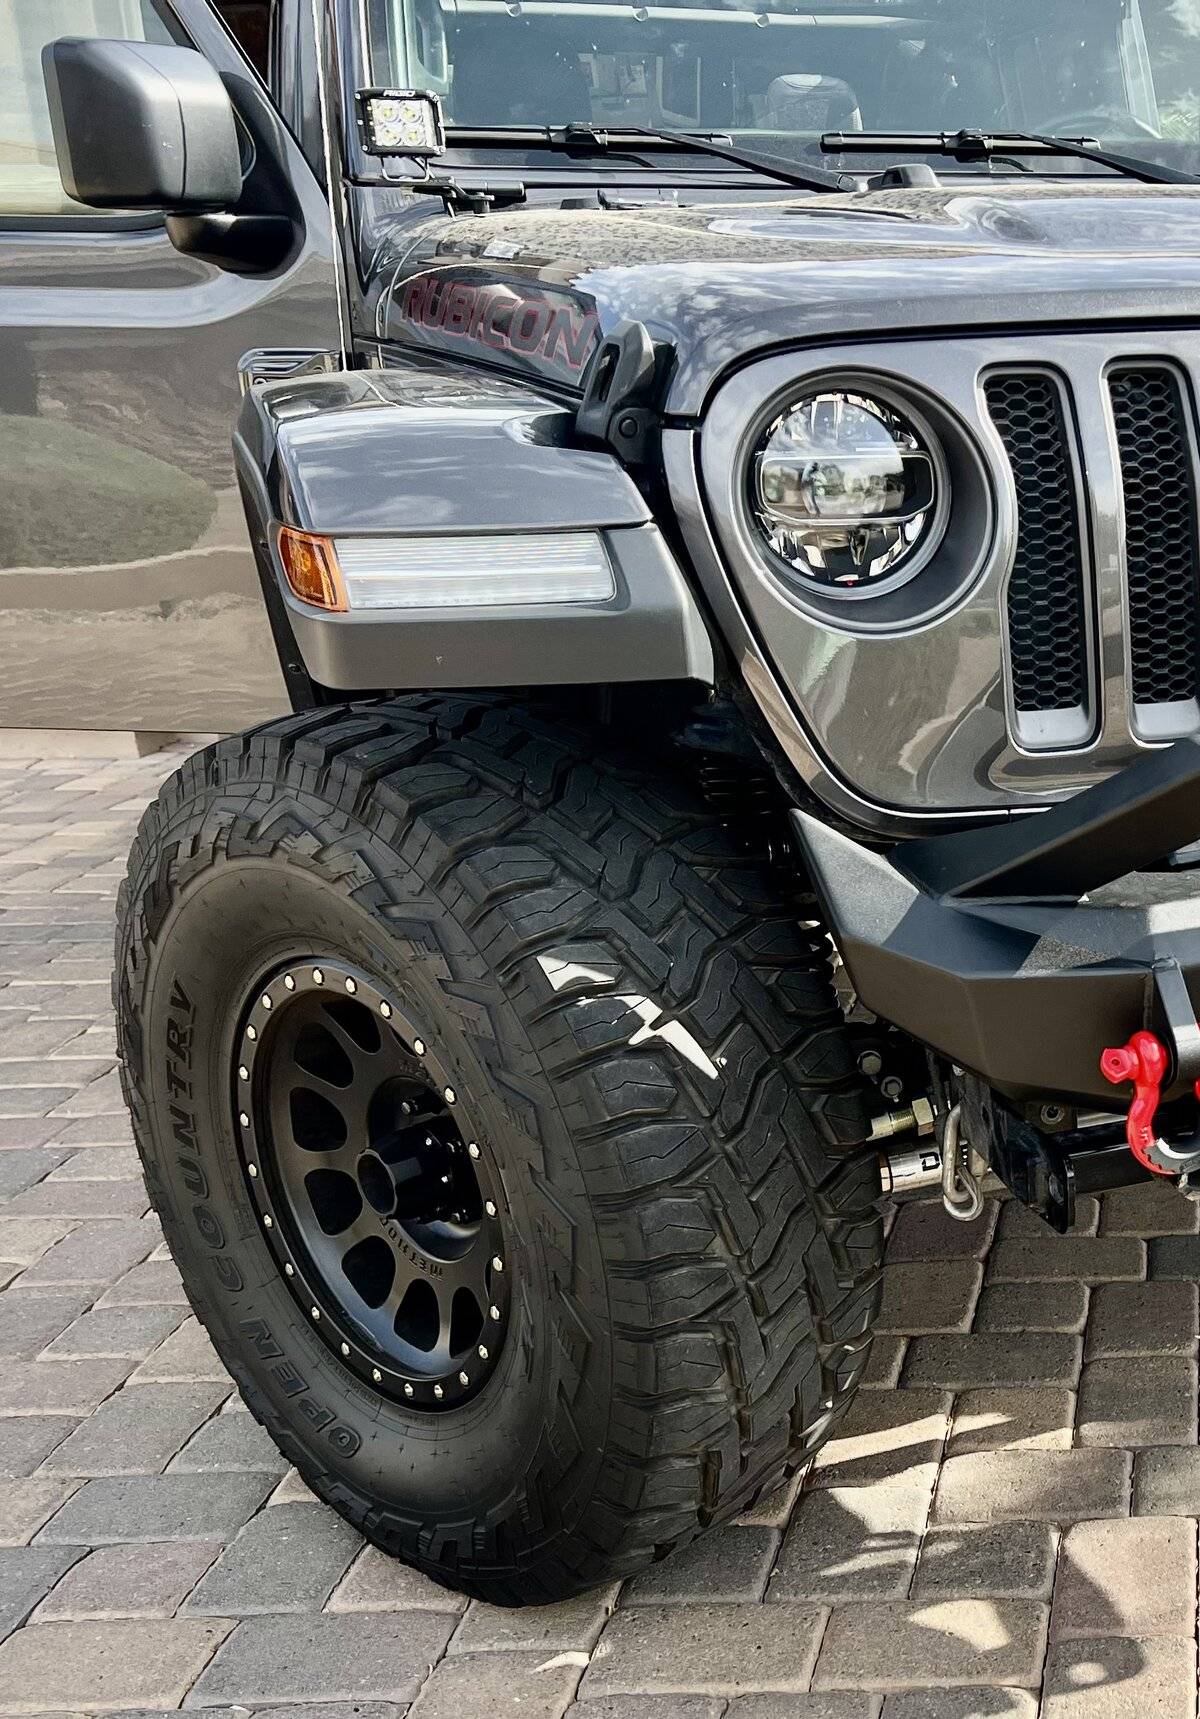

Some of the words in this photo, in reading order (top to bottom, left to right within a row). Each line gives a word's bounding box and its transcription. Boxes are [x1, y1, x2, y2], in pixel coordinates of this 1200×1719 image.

[402, 277, 598, 370] RUBICON
[164, 977, 243, 1292] COUNTRY
[238, 1316, 362, 1458] OPEN
